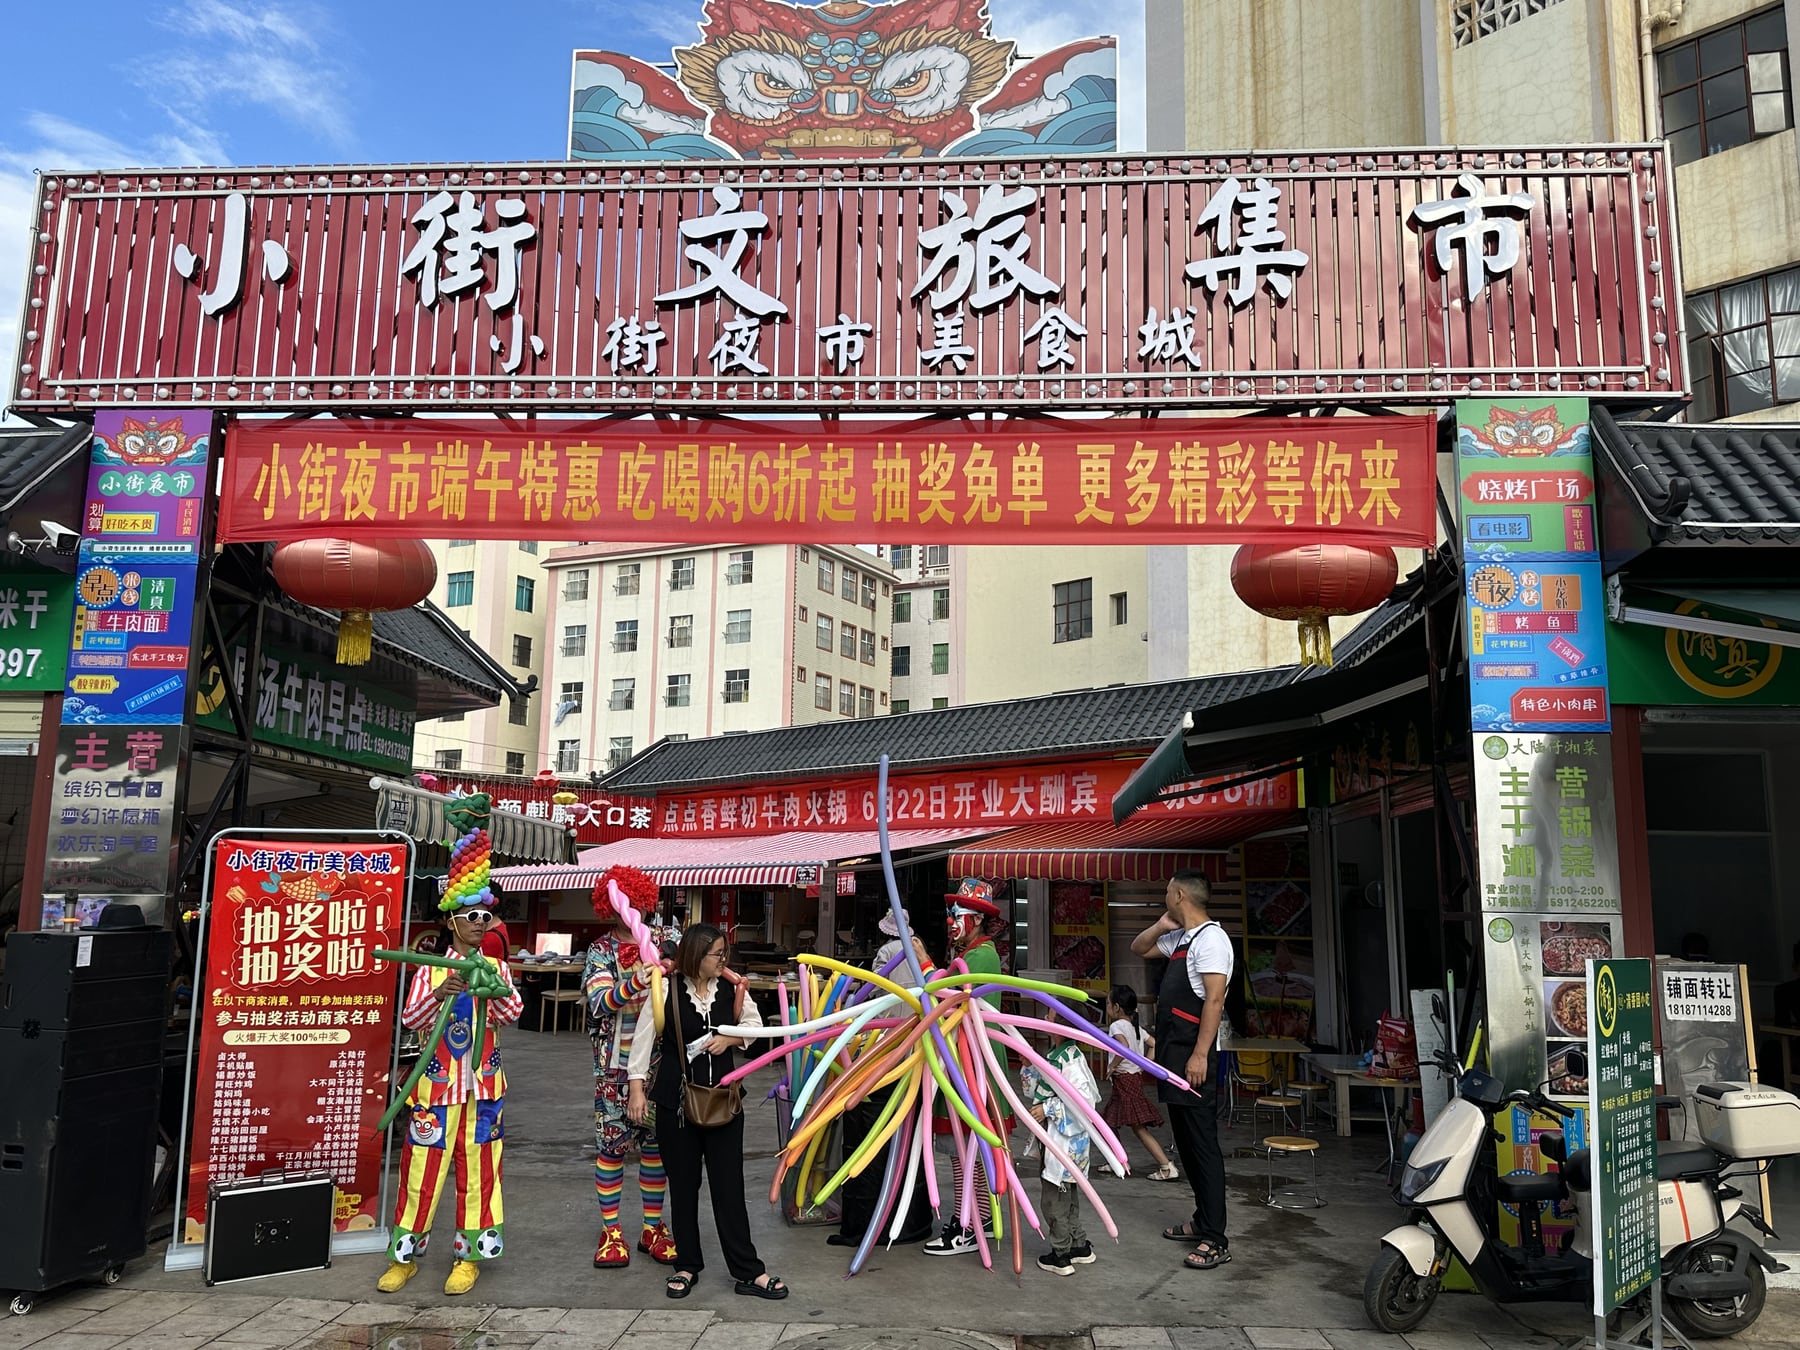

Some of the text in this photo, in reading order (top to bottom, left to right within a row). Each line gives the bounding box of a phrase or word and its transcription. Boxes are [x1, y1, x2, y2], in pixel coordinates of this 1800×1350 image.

[174, 173, 1536, 317] 小街文旅集市
[490, 304, 1203, 376] 小街夜市美食城
[102, 473, 192, 494] 小街夜市
[254, 438, 1403, 528] 小街夜市端午特惠 吃喝购6折起 抽奖免单 更多精彩等你来
[1478, 478, 1580, 501] 烧烤广场
[88, 503, 104, 531] 划算
[104, 518, 153, 530] 好吃不贵
[1477, 522, 1523, 536] 看电影
[1571, 509, 1586, 551] 歌手驻唱
[83, 574, 113, 602] 早点
[150, 579, 166, 610] 清真
[1473, 570, 1512, 603] 宵夜
[1521, 571, 1539, 606] 烧烤
[1555, 577, 1568, 609] 小龙虾
[106, 613, 160, 633] 牛肉面
[1515, 616, 1561, 630] 烤鱼
[131, 653, 185, 663] 东北手工饺子
[76, 678, 112, 690] 酸辣粉
[1520, 698, 1598, 712] 特色小肉串
[71, 731, 164, 771] 主营
[1499, 766, 1589, 799] 主营
[662, 789, 848, 833] 点点香鲜切牛肉火锅
[862, 771, 1098, 824] 6月22日开业大酬宾
[61, 807, 161, 825] 梦幻许愿瓶
[1501, 804, 1593, 838] 干锅
[58, 835, 159, 852] 欢乐淘气堡
[227, 849, 393, 874] 小街夜市美食城
[1502, 844, 1595, 878] 湘菜
[1543, 886, 1604, 896] 1:00-2:00
[1666, 976, 1732, 999] 铺面转让
[216, 1010, 381, 1026] 参与抽奖活动商家名单
[1667, 1004, 1732, 1016] 18187114288
[235, 1030, 341, 1043] 火爆开大奖100%中奖
[216, 1061, 254, 1070] 手机贴膜
[218, 1052, 247, 1061] 卤大师
[329, 1060, 365, 1068] 原汤牛肉
[336, 1069, 364, 1077] 七公主
[214, 1089, 243, 1098] 黄焖鸡
[323, 1132, 359, 1141] 建水烧烤
[209, 1153, 266, 1162] 泸西小锅米线
